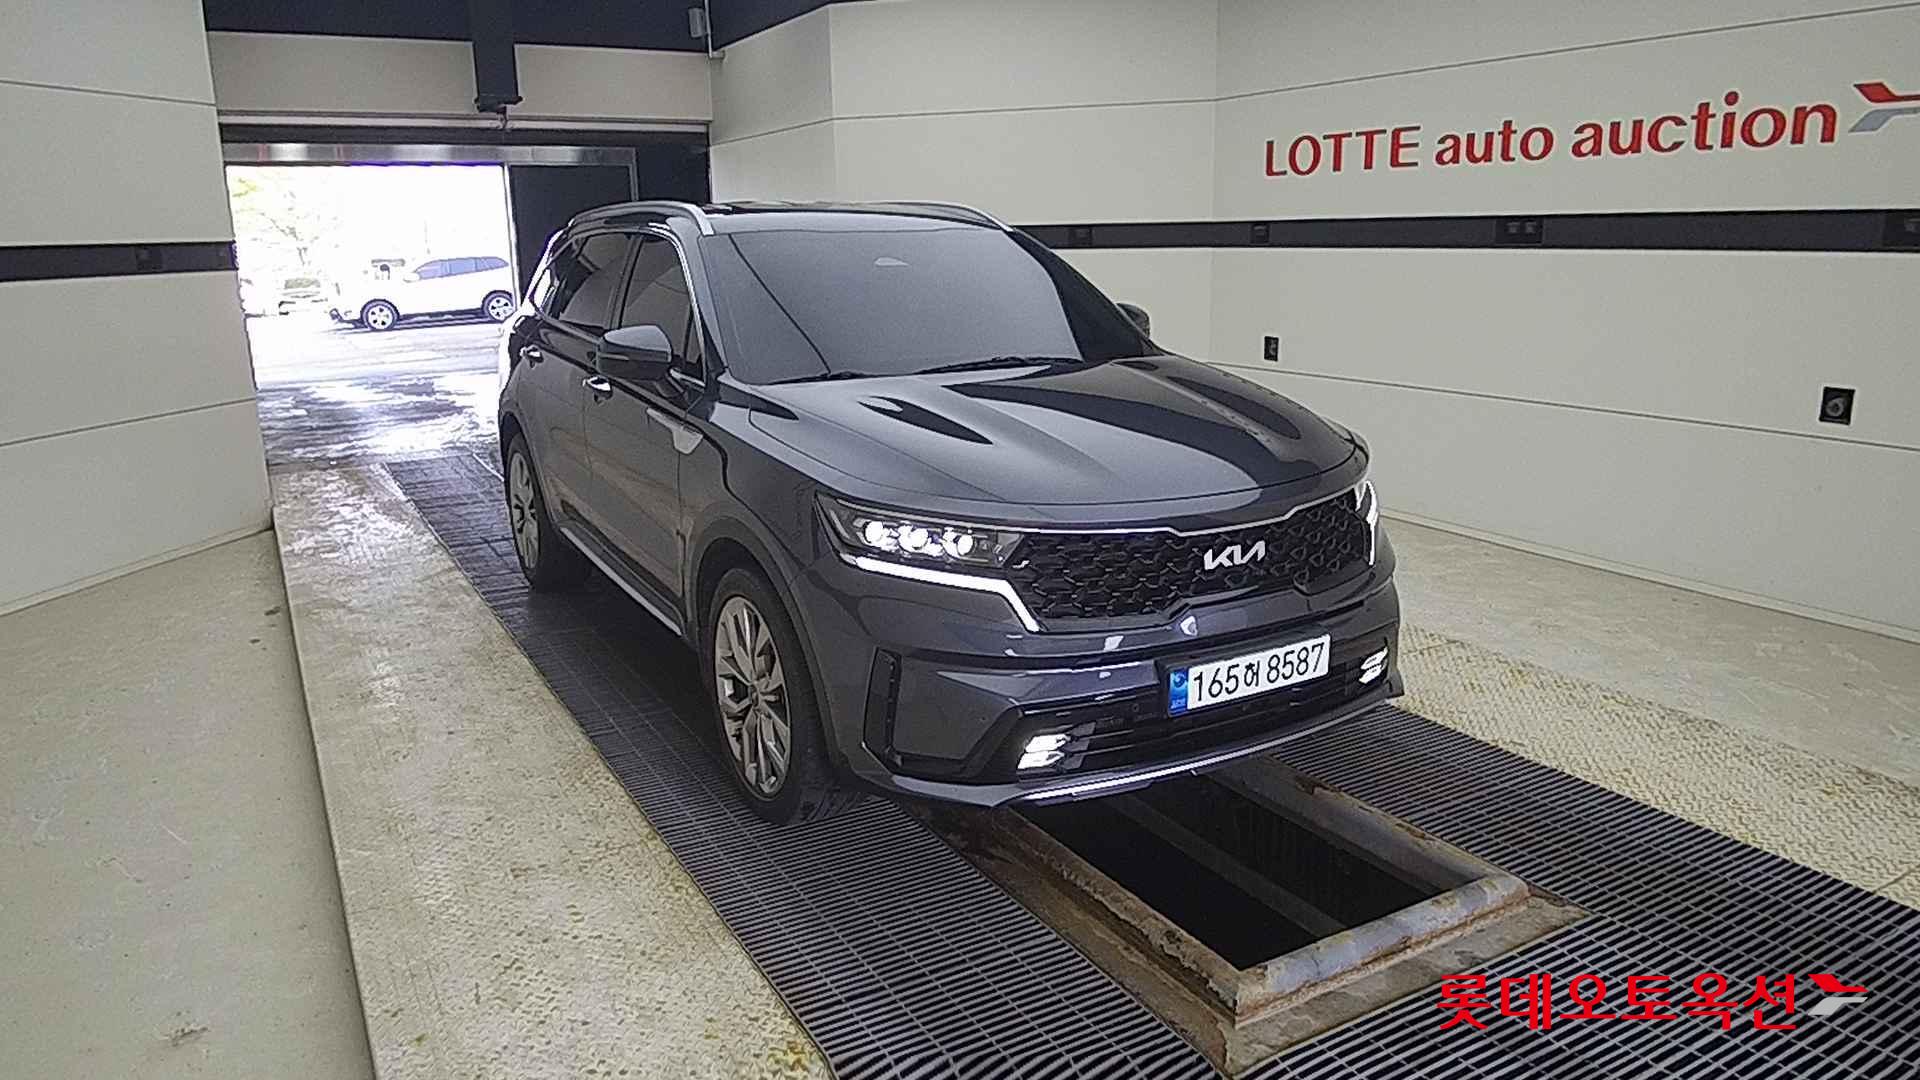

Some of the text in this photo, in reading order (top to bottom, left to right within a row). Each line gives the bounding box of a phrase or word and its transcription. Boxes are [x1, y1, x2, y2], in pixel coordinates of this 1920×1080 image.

[1265, 90, 1838, 177] LOTTE auto auction
[1203, 540, 1266, 571] KIA
[1266, 642, 1325, 683] 8587
